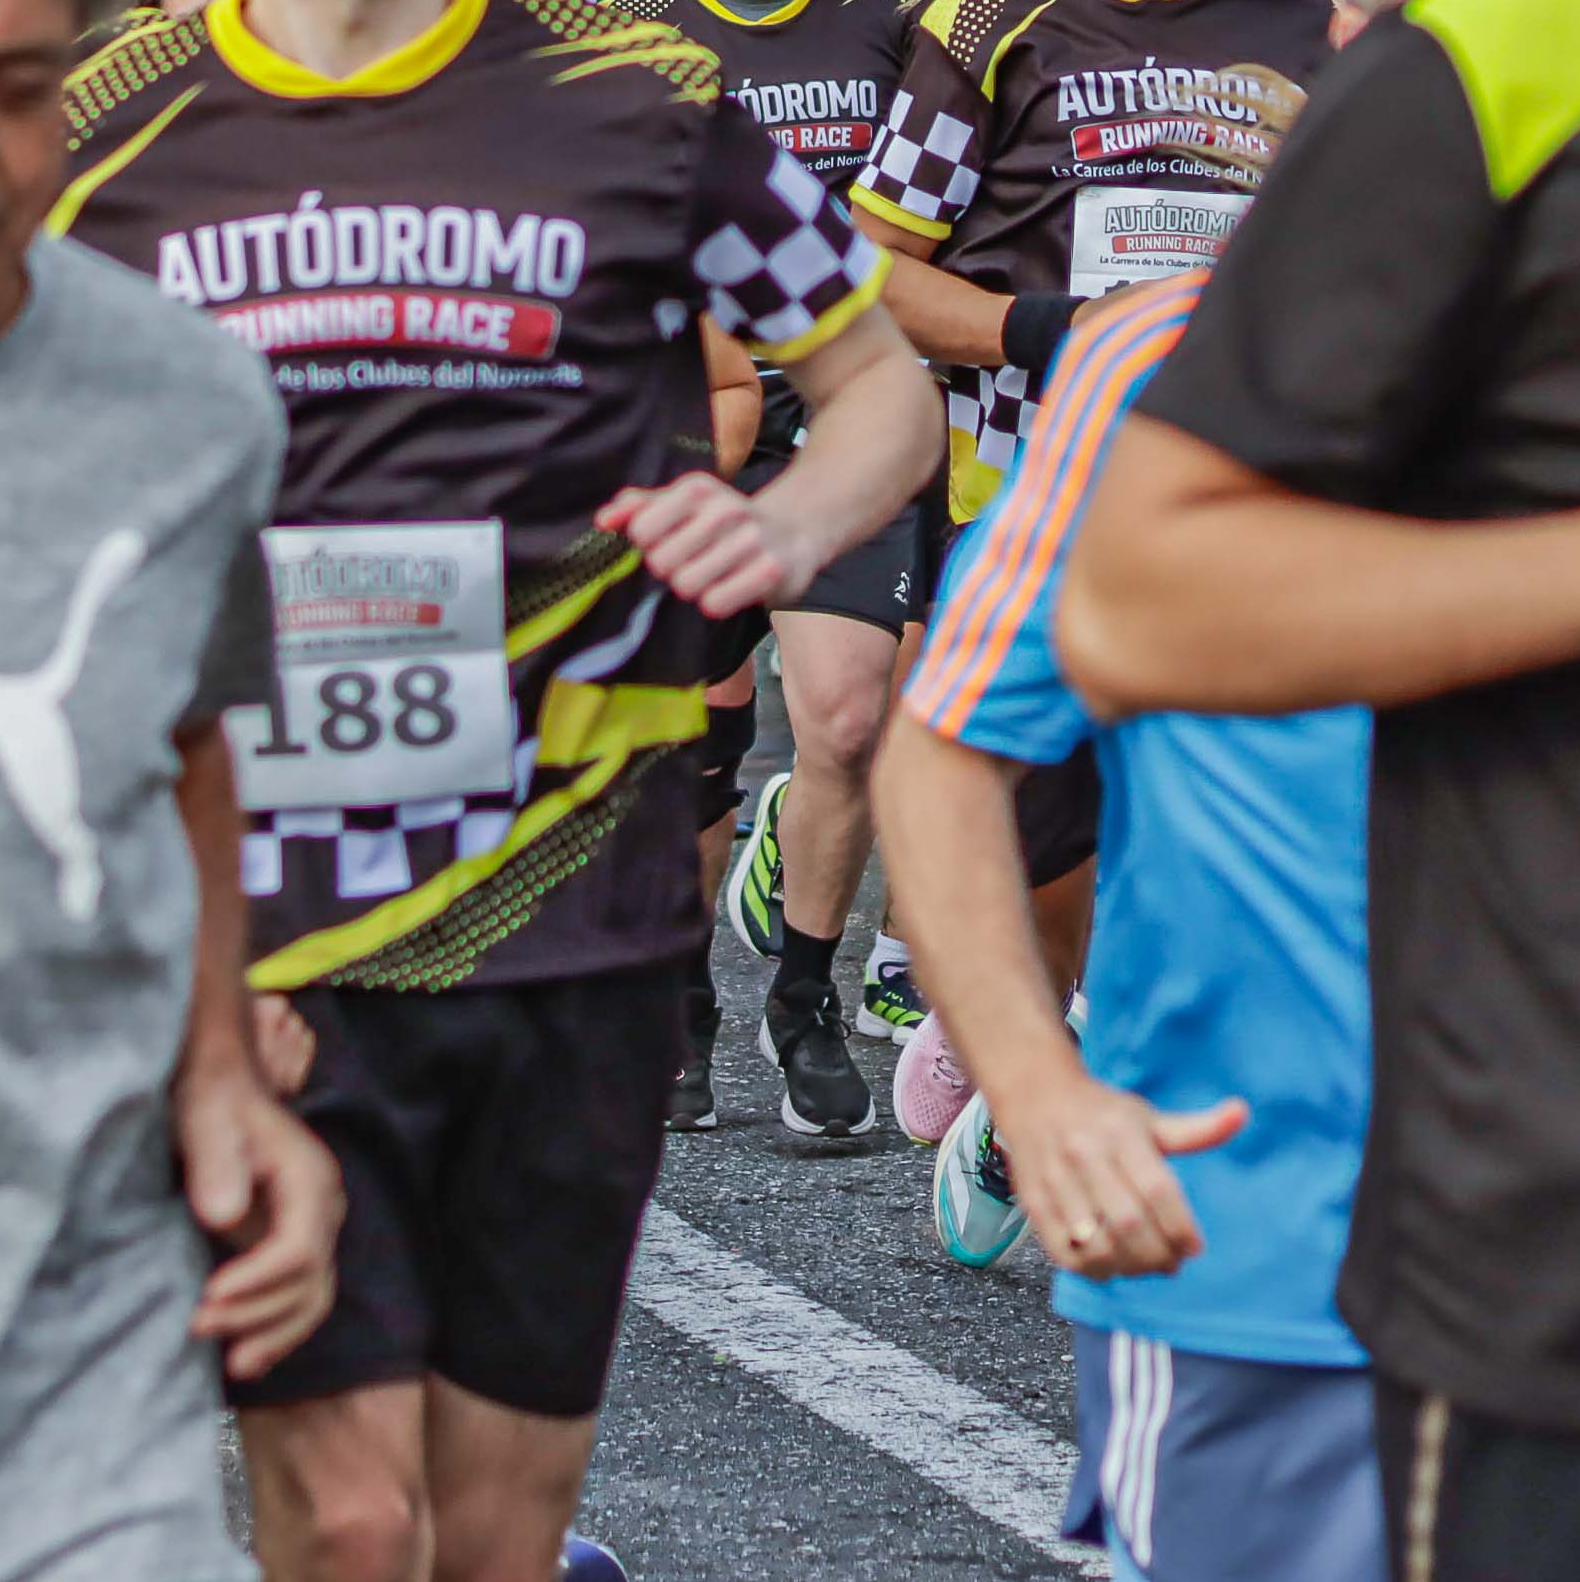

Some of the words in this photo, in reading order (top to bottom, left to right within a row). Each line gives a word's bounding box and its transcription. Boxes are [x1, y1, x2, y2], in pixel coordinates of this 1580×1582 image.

[726, 78, 877, 123] ÓDROMO
[800, 126, 853, 149] RACE
[1099, 121, 1207, 154] RUNNING
[815, 157, 834, 170] del
[1052, 165, 1070, 178] La
[1073, 162, 1124, 178] Carrera
[1127, 160, 1144, 174] de
[1146, 159, 1166, 174] los
[1169, 159, 1220, 178] Clubes
[1225, 165, 1247, 181] del
[157, 190, 587, 307] AUTÓDROMO
[1100, 256, 1109, 264] La
[1110, 256, 1140, 266] Carrera
[1141, 257, 1152, 266] de
[1153, 258, 1164, 267] los
[1166, 258, 1191, 268] Clubes
[1126, 236, 1182, 251] RUNNING
[1185, 237, 1216, 255] RACE
[403, 295, 515, 351] RACE
[306, 362, 345, 391] los
[346, 358, 432, 390] Clubes
[433, 361, 474, 390] del
[254, 664, 458, 757] 188
